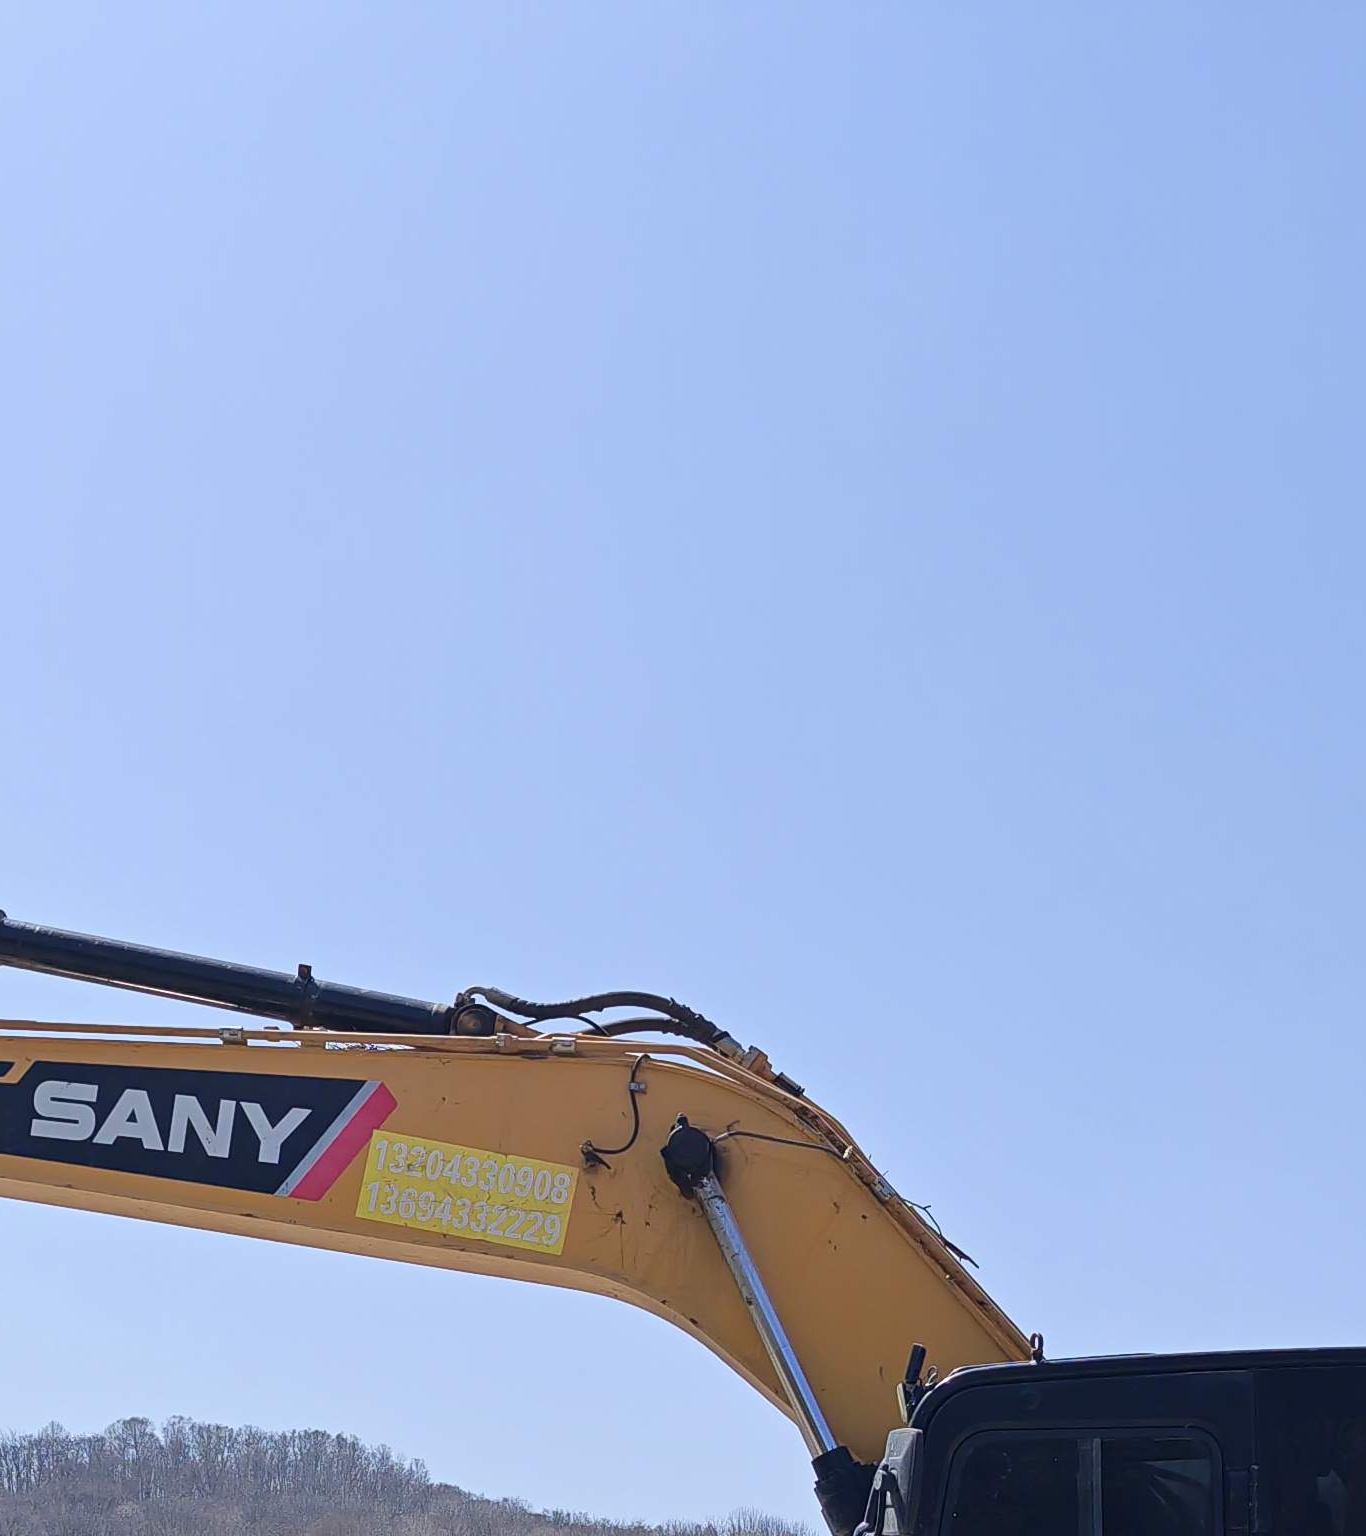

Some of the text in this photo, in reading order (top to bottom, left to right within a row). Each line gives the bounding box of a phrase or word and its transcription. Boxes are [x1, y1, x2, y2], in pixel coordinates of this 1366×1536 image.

[31, 1080, 312, 1164] SANY
[375, 1139, 572, 1204] 13204330908
[366, 1181, 562, 1247] 13694332229
